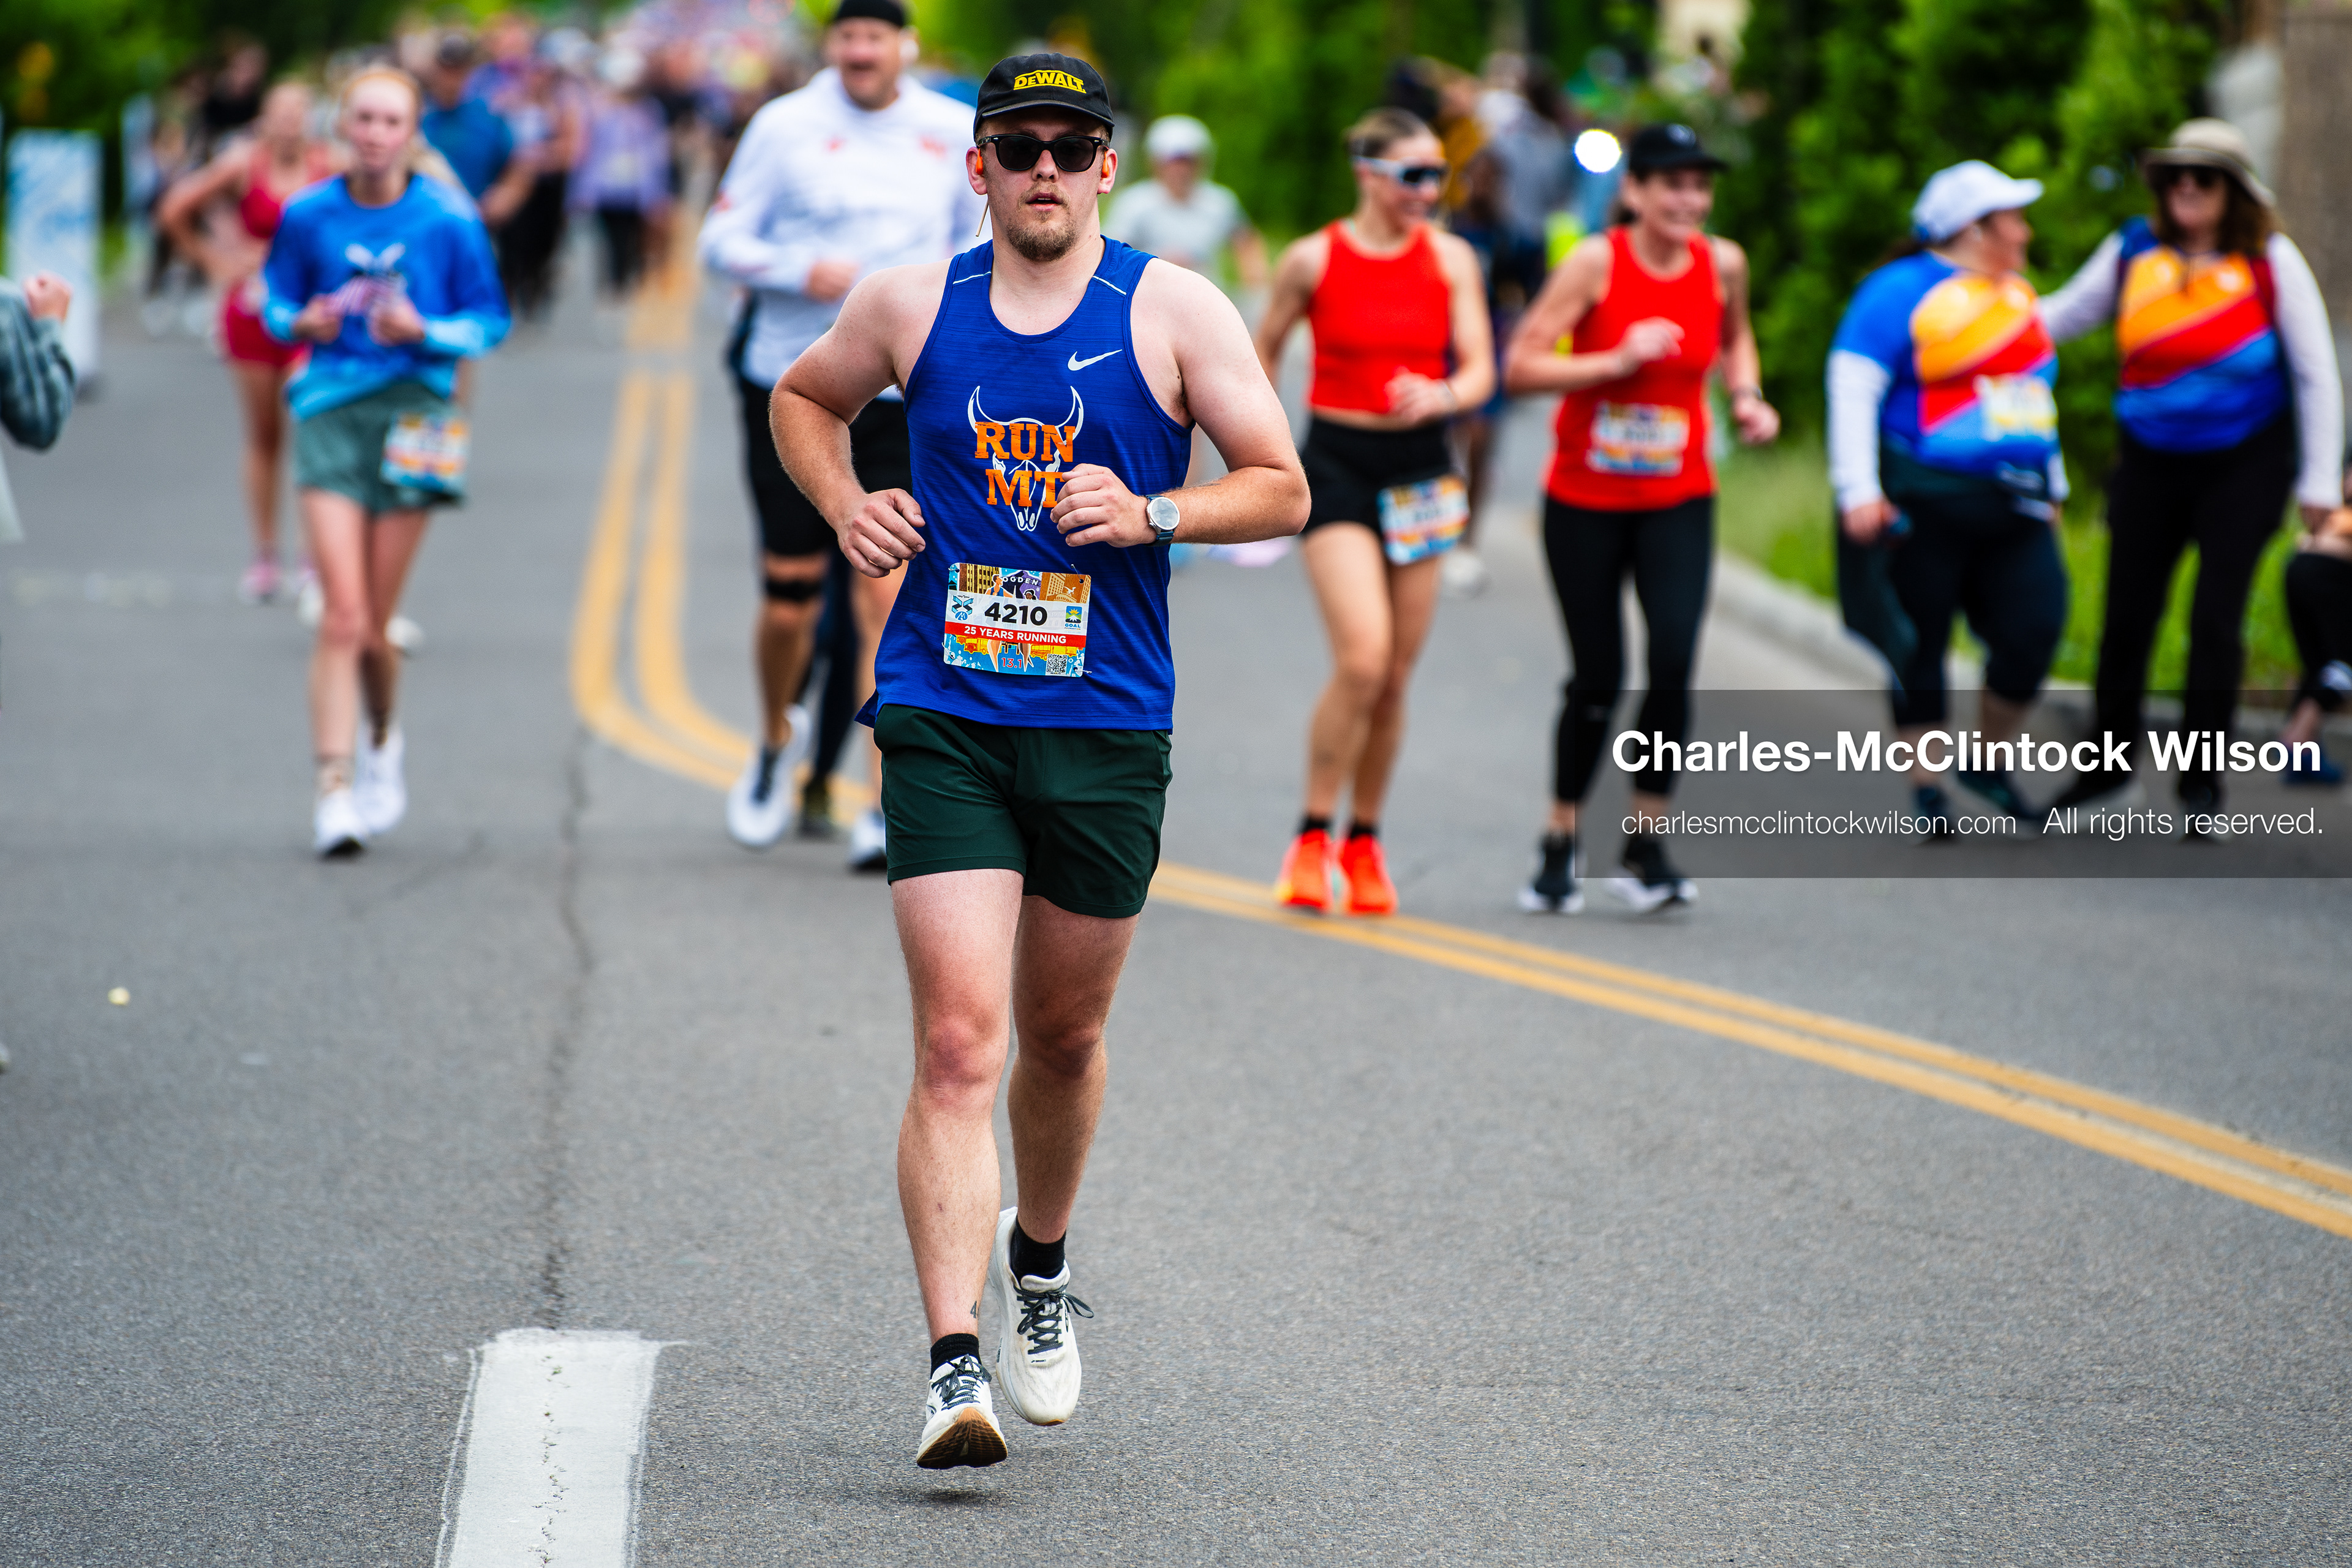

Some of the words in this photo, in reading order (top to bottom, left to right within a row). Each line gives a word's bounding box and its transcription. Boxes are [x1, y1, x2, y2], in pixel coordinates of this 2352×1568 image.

[974, 421, 1076, 462] RUN
[985, 469, 1066, 508] MT
[1003, 576, 1039, 586] OGDEN
[984, 602, 1048, 625] 4210
[964, 626, 976, 635] 25
[980, 628, 1014, 639] YEARS
[1017, 632, 1066, 643] RUNNING
[1001, 658, 1022, 668] 13.1
